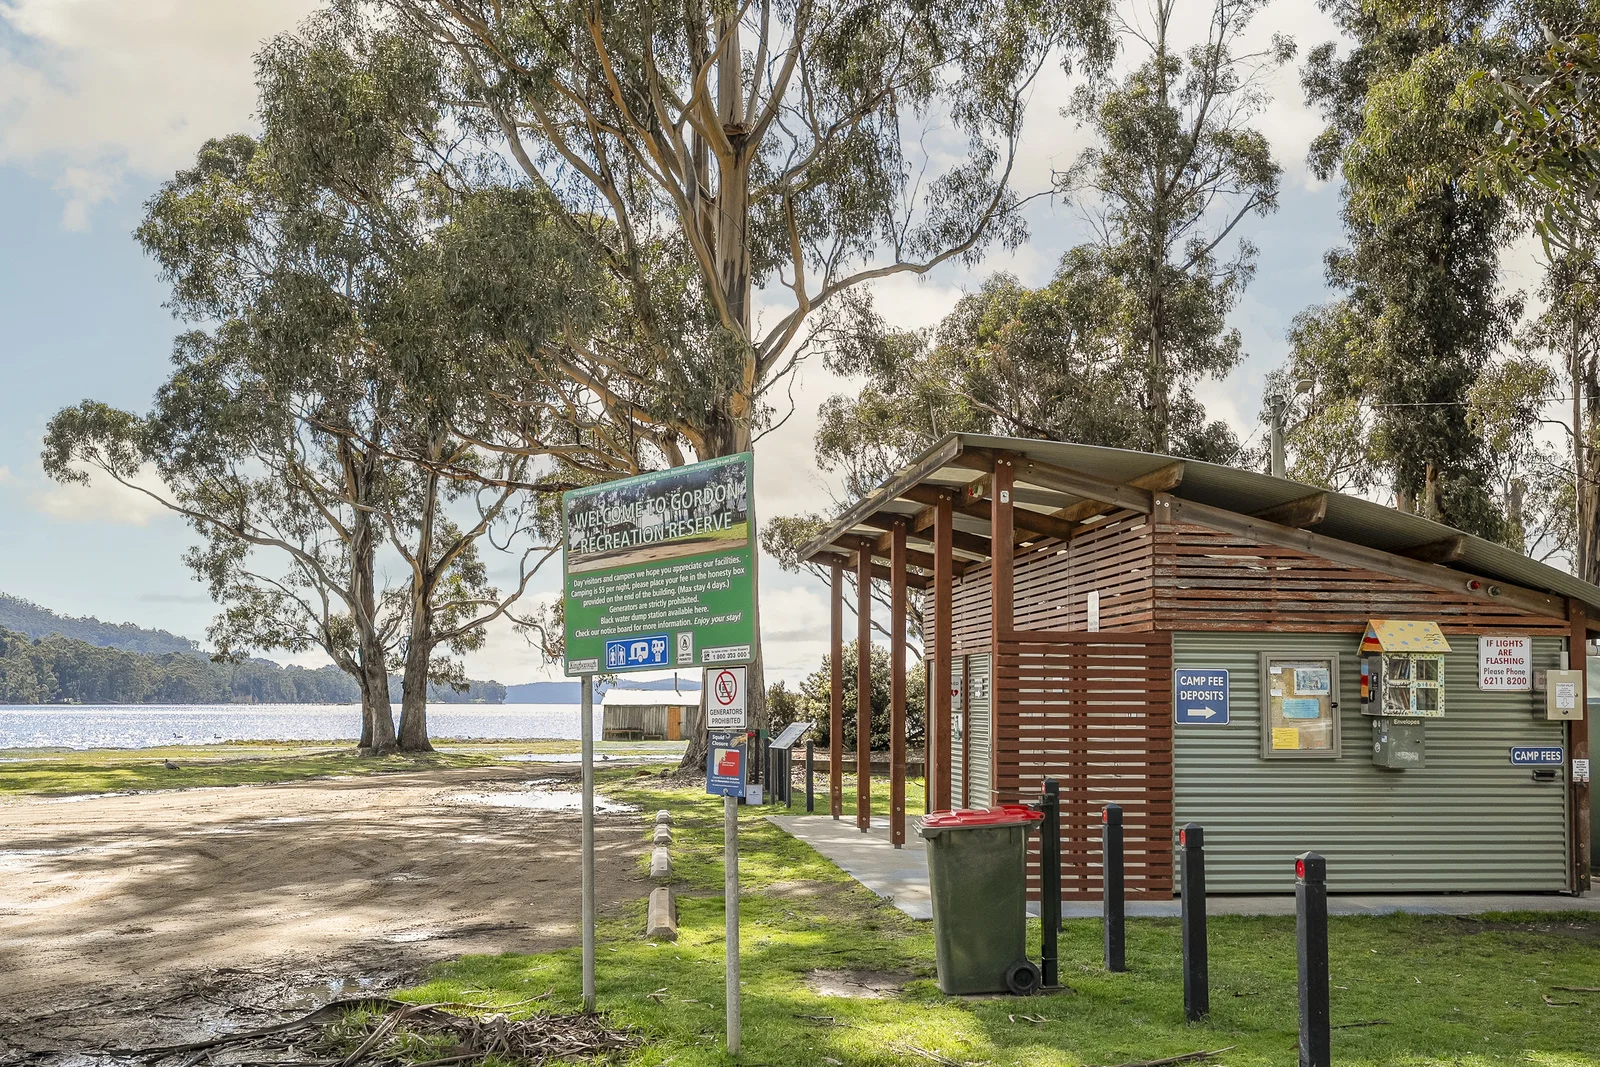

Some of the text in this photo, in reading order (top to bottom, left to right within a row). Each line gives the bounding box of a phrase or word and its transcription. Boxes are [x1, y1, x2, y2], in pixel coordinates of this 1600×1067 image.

[575, 484, 738, 529] WELCOME TO GORDON
[580, 512, 732, 554] RECREATION RESERVE
[571, 589, 592, 598] Camping
[606, 586, 615, 594] per
[616, 583, 631, 592] night,
[632, 581, 649, 590] please
[650, 579, 664, 588] place
[665, 576, 678, 586] your
[680, 574, 689, 582] fee
[697, 572, 706, 580] the
[708, 569, 731, 578] honesty
[574, 580, 584, 588] Day
[584, 577, 602, 585] visitors
[603, 574, 613, 582] and
[614, 572, 635, 581] campers
[646, 568, 660, 577] hope
[661, 567, 671, 576] you
[672, 562, 702, 573] appreciate
[715, 556, 741, 566] facilities.
[583, 597, 605, 607] provided
[624, 592, 634, 600] end
[652, 587, 676, 597] building.
[678, 586, 692, 594] (Max
[693, 584, 705, 592] stay
[712, 579, 729, 590] days.)
[609, 604, 638, 613] Generators
[648, 599, 666, 608] strictly
[668, 595, 699, 607] prohibited.
[575, 629, 591, 638] Check
[617, 624, 632, 633] board
[658, 618, 692, 628] information.
[694, 617, 710, 626] Enjoy
[711, 616, 725, 624] your
[726, 613, 741, 623] stay!
[601, 616, 614, 624] Black
[631, 613, 647, 621] dump
[648, 610, 667, 619] station
[668, 607, 693, 616] available
[1180, 676, 1224, 686] CAMP FEE
[1180, 690, 1224, 700] DEPOSITS
[1514, 751, 1561, 760] CAMP FEES
